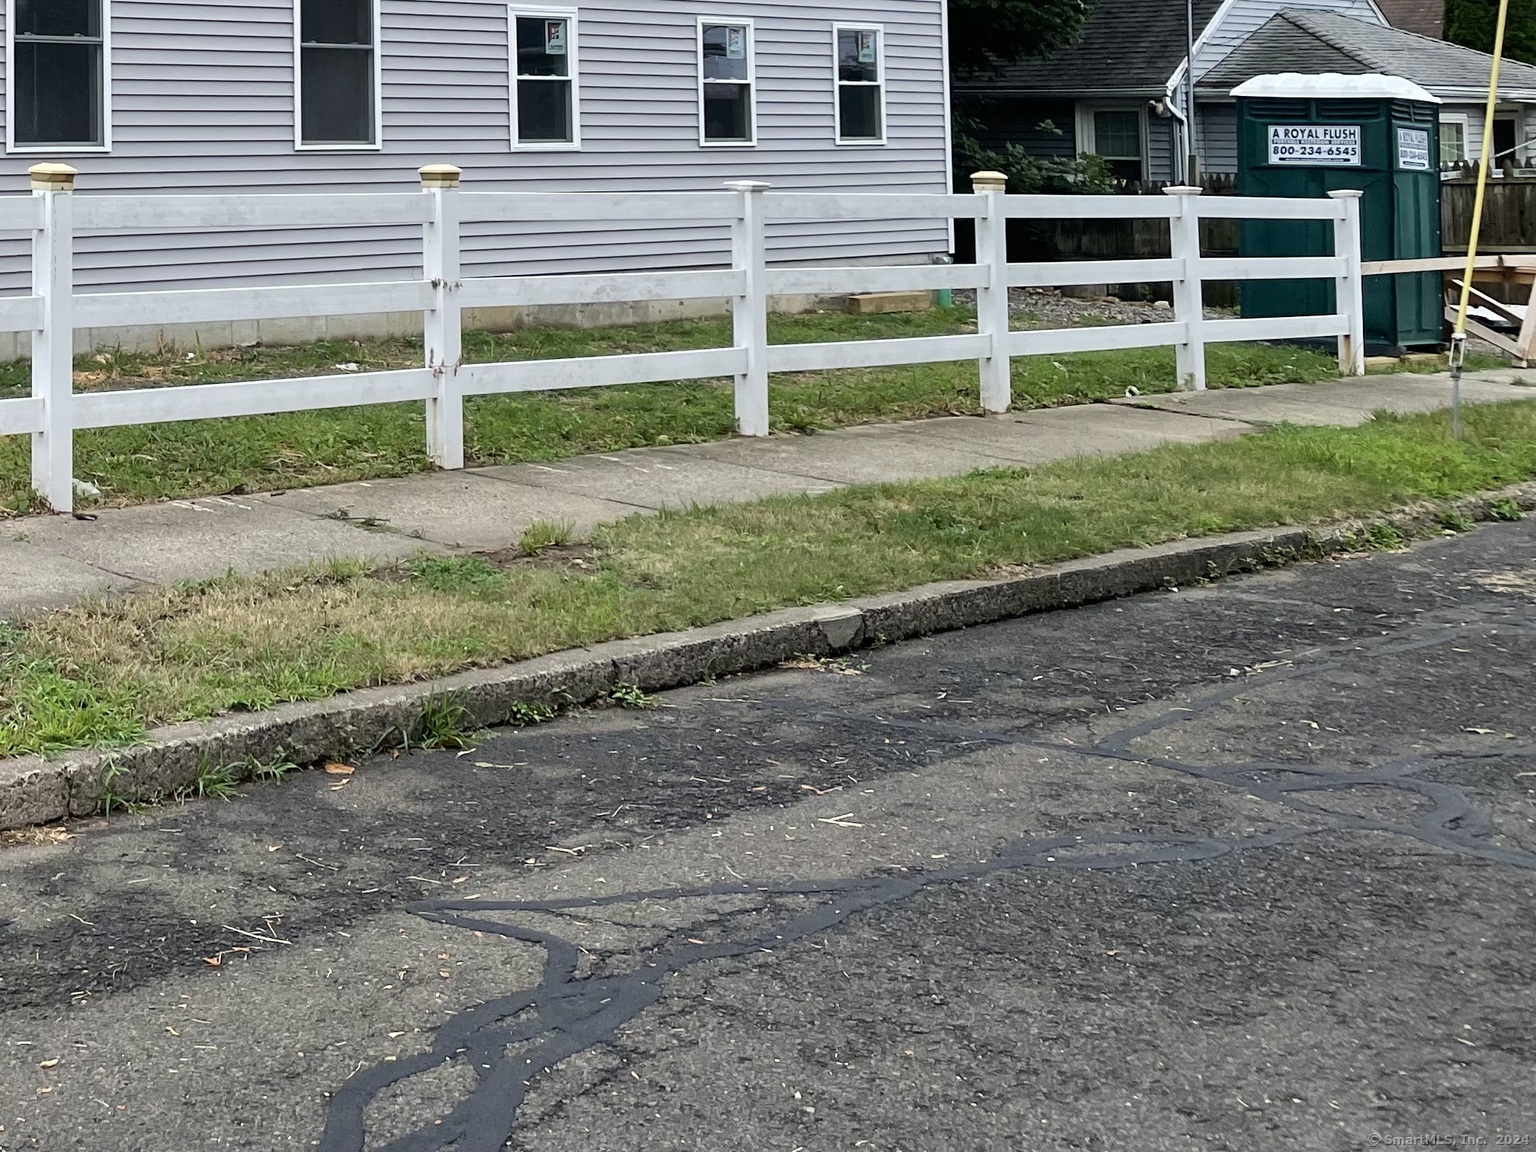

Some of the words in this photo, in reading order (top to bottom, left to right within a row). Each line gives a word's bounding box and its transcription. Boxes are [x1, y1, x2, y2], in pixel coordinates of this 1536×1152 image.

[1272, 128, 1280, 139] A
[1284, 128, 1320, 139] ROYAL
[1324, 129, 1356, 139] FLUSH
[1273, 146, 1357, 156] 800-234-6545
